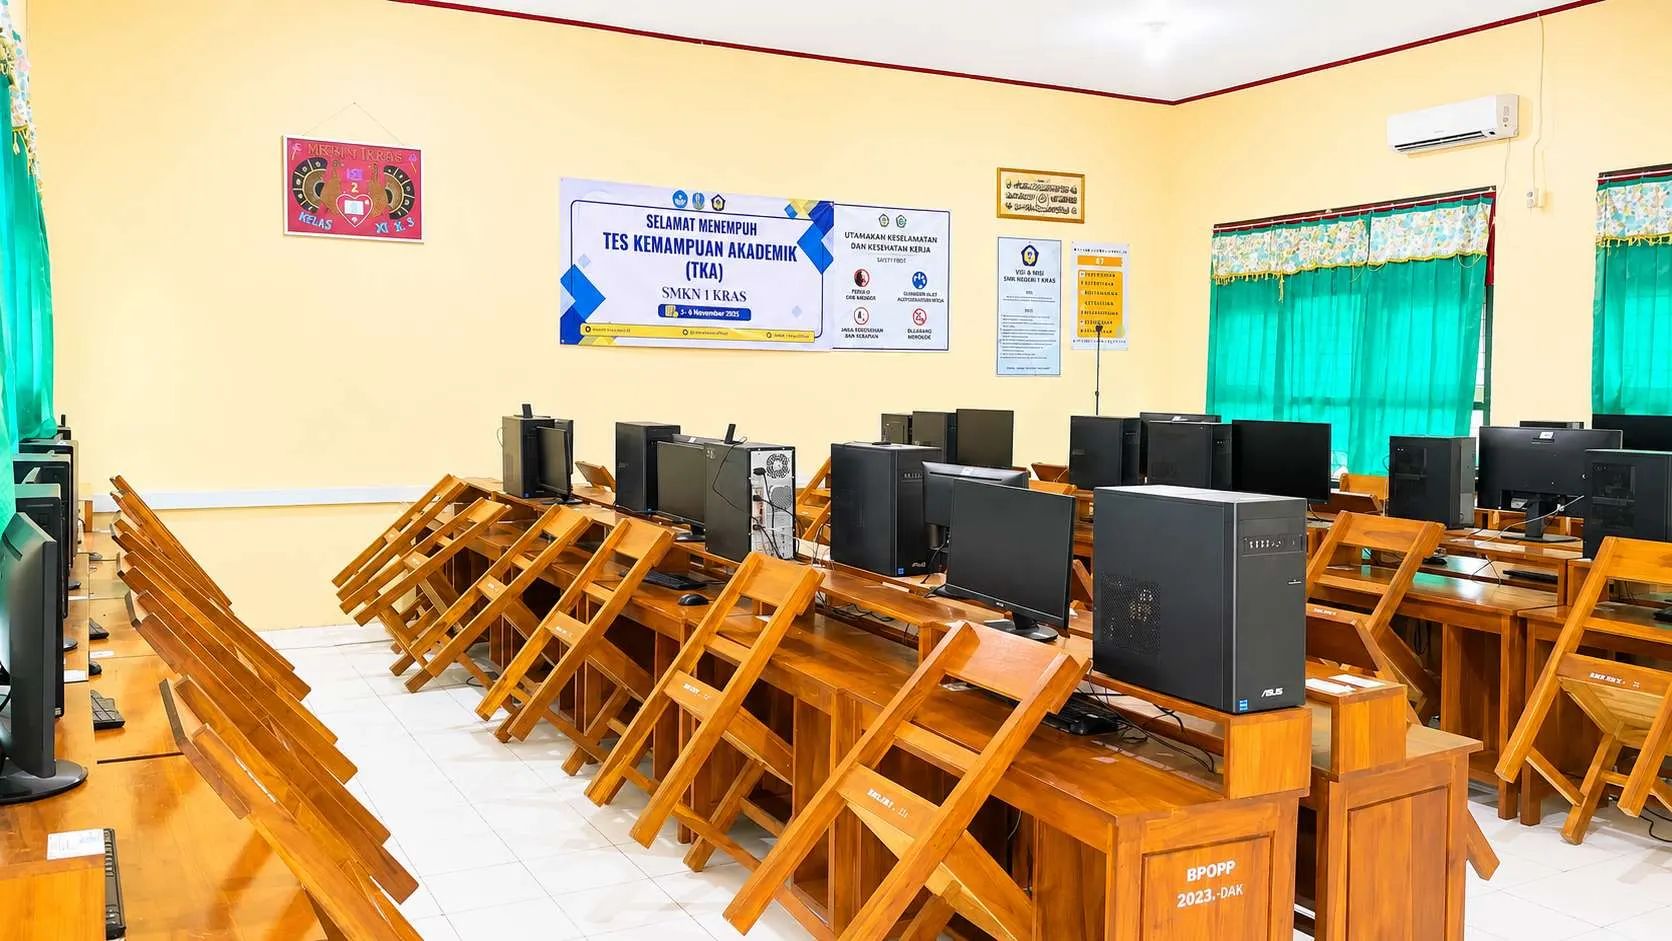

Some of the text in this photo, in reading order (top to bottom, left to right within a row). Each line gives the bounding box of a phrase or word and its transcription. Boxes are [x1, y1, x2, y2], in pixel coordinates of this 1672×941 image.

[298, 212, 332, 230] KELAS
[376, 222, 388, 233] XI
[646, 214, 757, 236] SELAMAT MENEMPUH
[844, 231, 938, 244] UTAMAKAN KESELAMATAN
[603, 232, 797, 262] TES KEMAMPUAN AKADEMIK
[850, 242, 866, 250] DAN
[867, 243, 908, 252] KESEHATAN
[686, 261, 723, 283] (TKA)
[662, 286, 747, 303] SMKN 1 KRAS
[693, 309, 725, 317] November
[1260, 687, 1283, 698] ASUS
[1187, 860, 1236, 882] BPOPP
